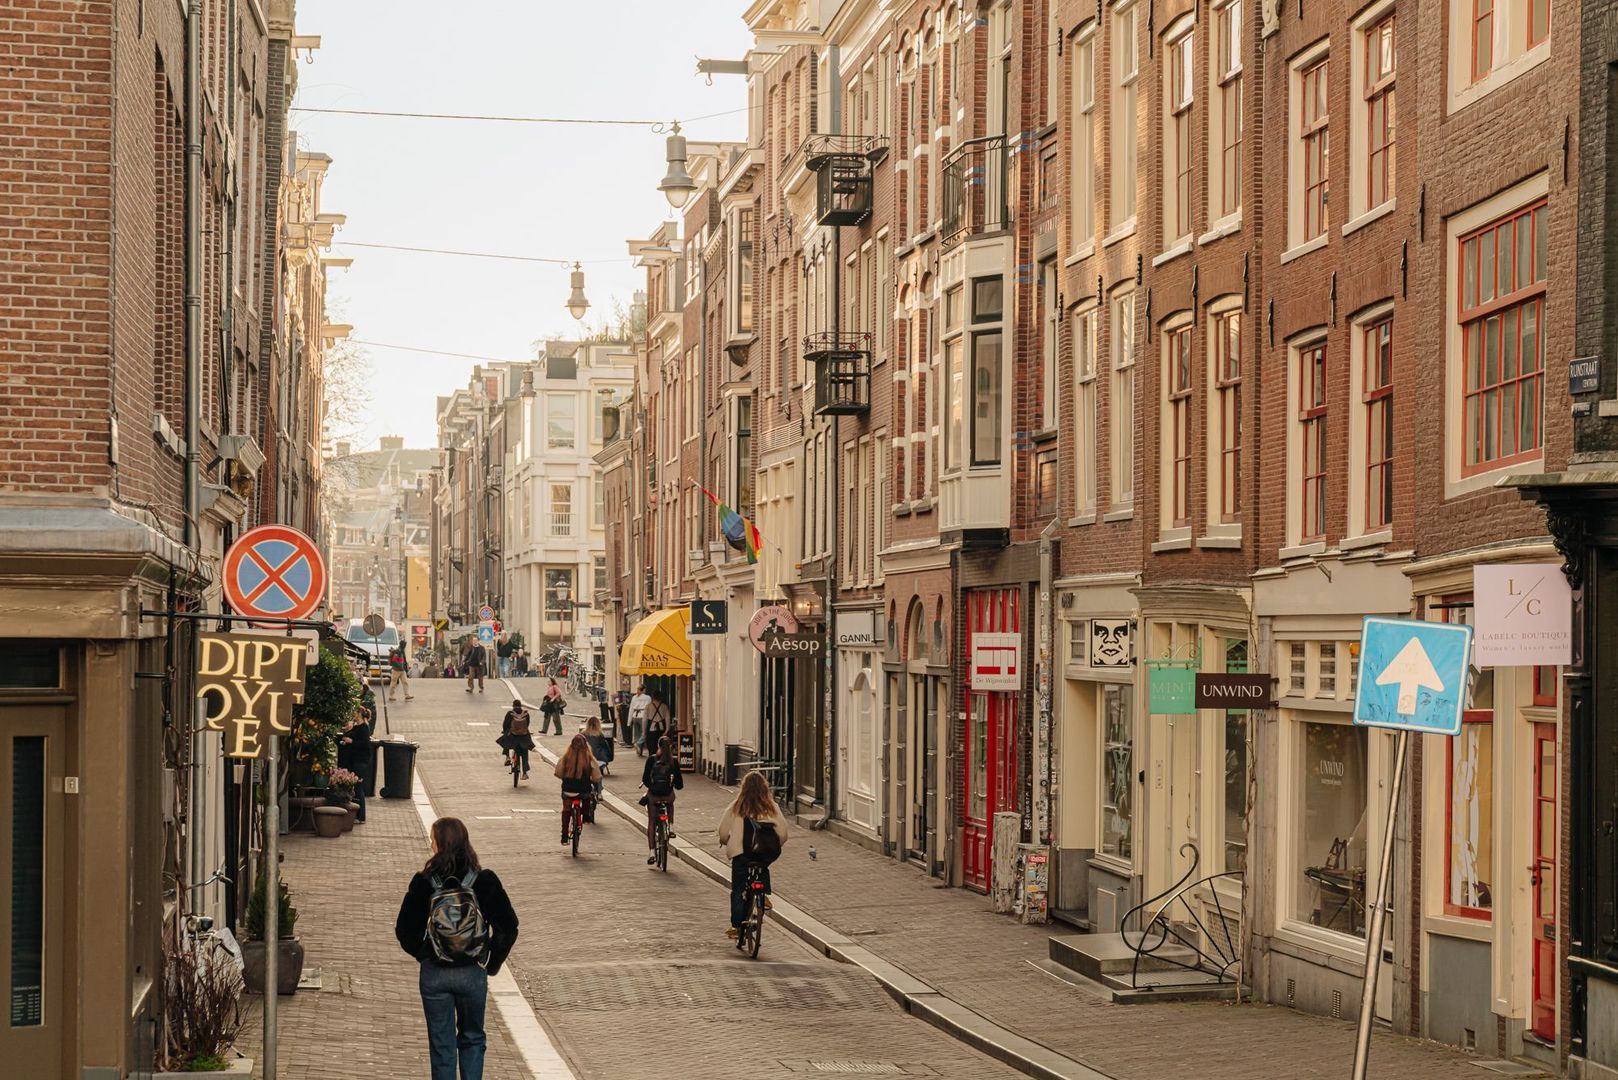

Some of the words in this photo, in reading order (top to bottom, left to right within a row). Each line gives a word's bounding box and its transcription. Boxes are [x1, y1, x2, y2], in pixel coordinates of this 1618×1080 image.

[840, 634, 870, 643] GANNI
[1521, 631, 1569, 641] BOUTIQUE
[198, 638, 307, 683] DIPT
[641, 653, 669, 662] KAAS
[1152, 681, 1194, 694] MINT
[1202, 685, 1263, 698] UNWIND
[1320, 760, 1344, 777] UNWIND
